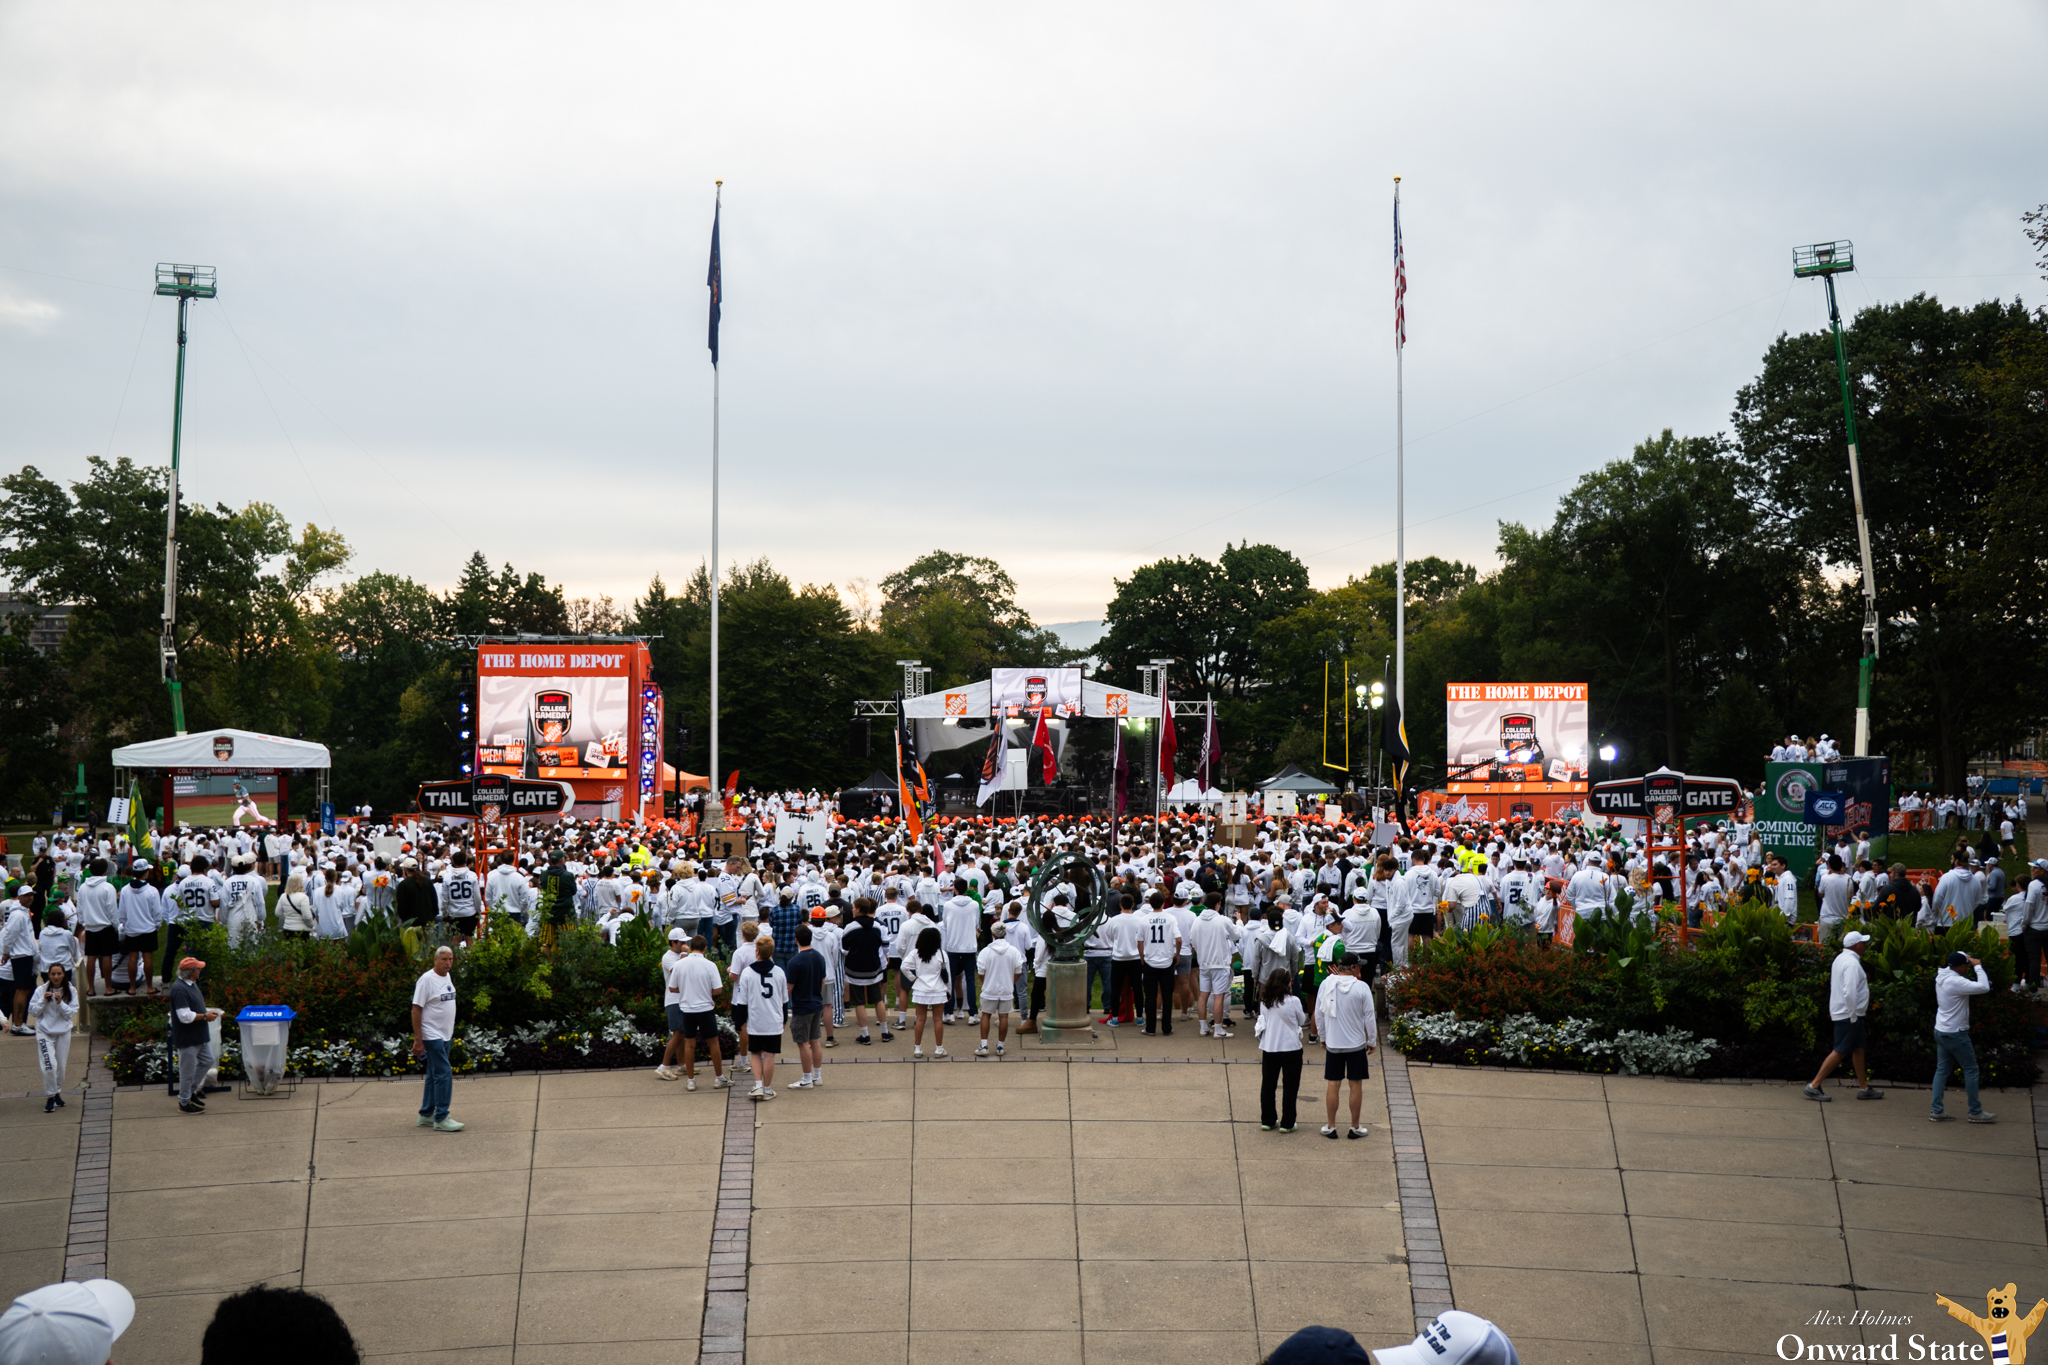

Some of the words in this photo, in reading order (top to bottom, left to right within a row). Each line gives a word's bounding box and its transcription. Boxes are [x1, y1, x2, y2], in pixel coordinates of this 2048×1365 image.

[482, 654, 514, 668] THE
[520, 654, 565, 668] HOME
[570, 654, 624, 668] DEPOT
[1448, 686, 1480, 699] THE
[1485, 686, 1529, 699] HOME
[1534, 686, 1584, 699] DEPOT
[425, 792, 469, 806] TAIL
[513, 791, 557, 806] GATE
[1596, 793, 1641, 807] TAIL
[1686, 791, 1733, 806] GATE
[1554, 805, 1566, 816] THE
[1750, 820, 1816, 833] DOMINION
[1784, 834, 1816, 846] LINE
[450, 881, 472, 899] 26
[1304, 880, 1314, 891] 44
[184, 888, 205, 907] 26
[806, 894, 820, 907] 26
[883, 917, 900, 934] 10
[1150, 925, 1164, 943] 11
[760, 973, 773, 998] 5
[1436, 1323, 1451, 1341] The
